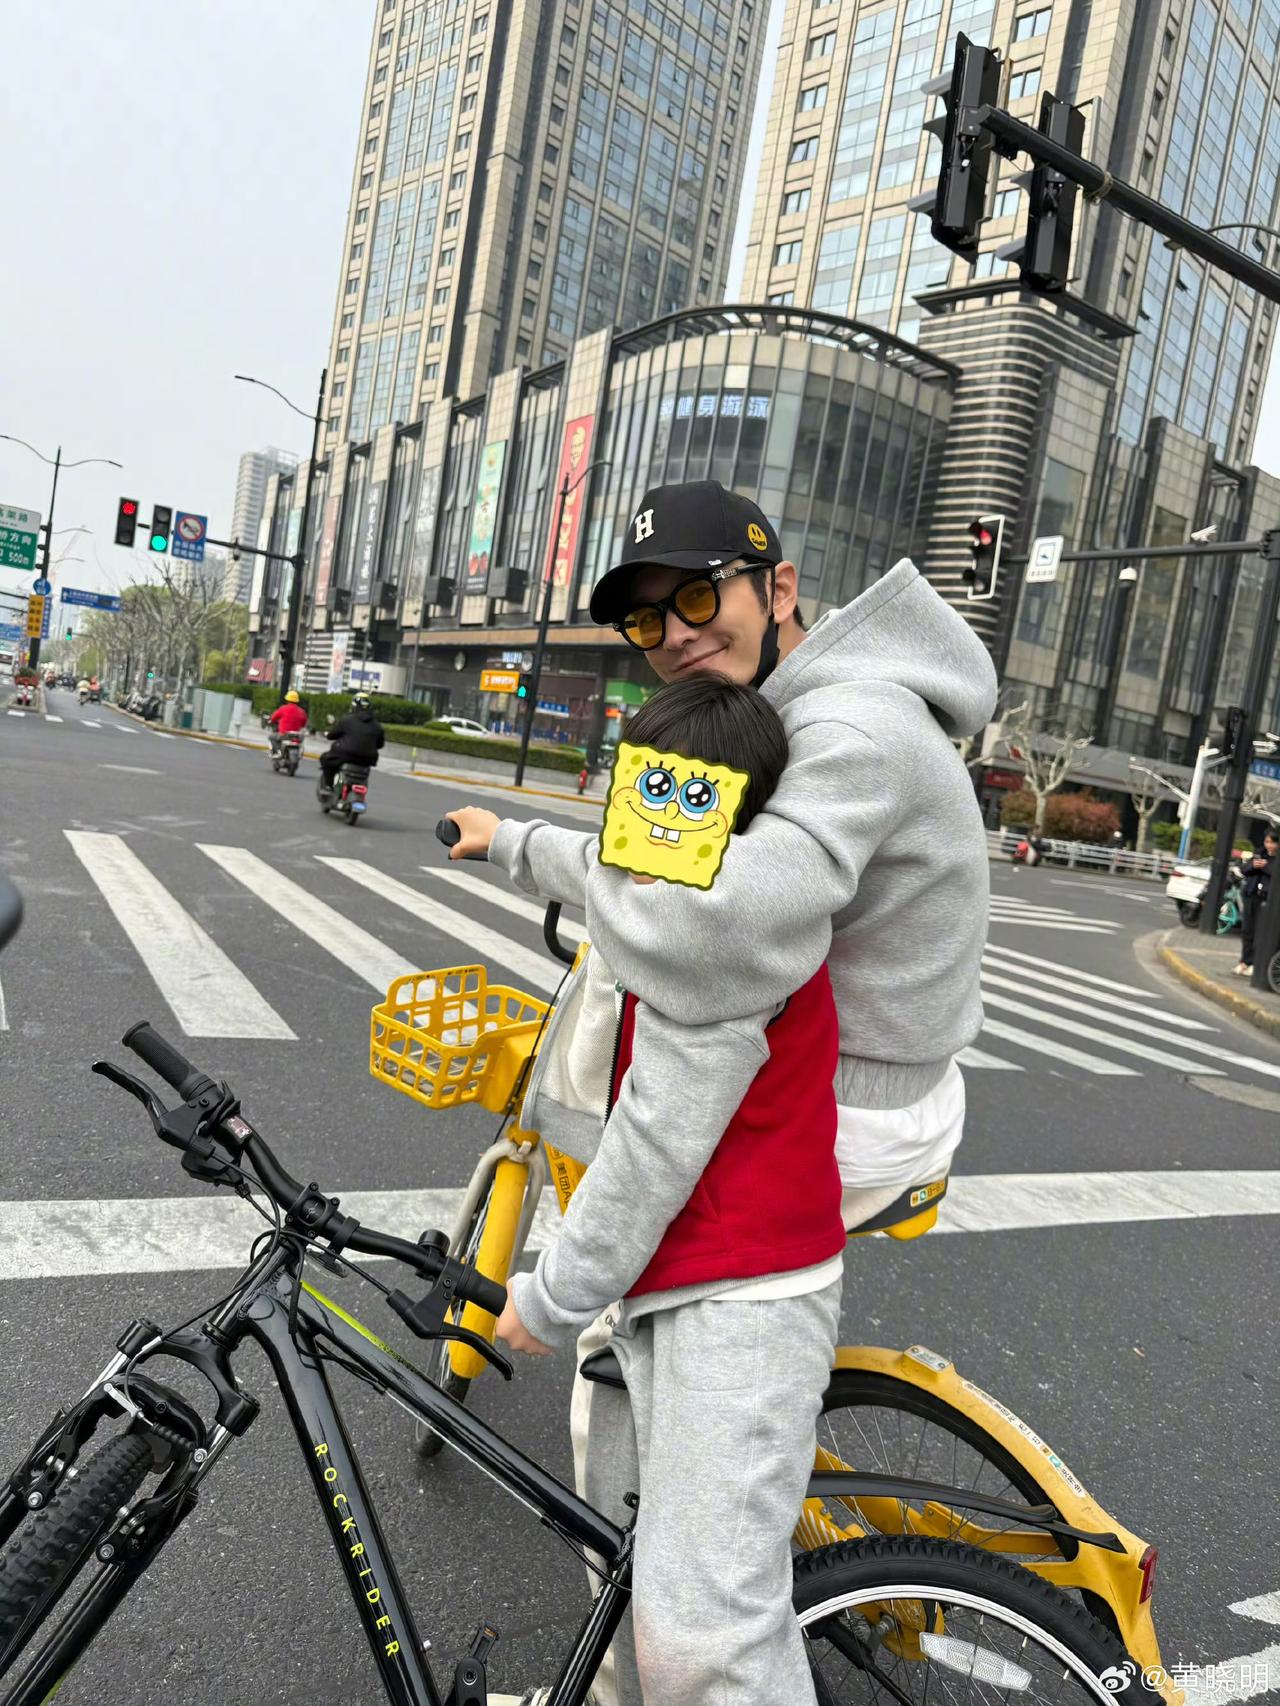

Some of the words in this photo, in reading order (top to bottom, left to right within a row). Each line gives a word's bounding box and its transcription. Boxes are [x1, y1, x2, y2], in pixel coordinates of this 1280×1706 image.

[635, 508, 655, 544] H
[8, 551, 30, 565] 500m
[315, 1442, 400, 1657] ROCKRIDER
